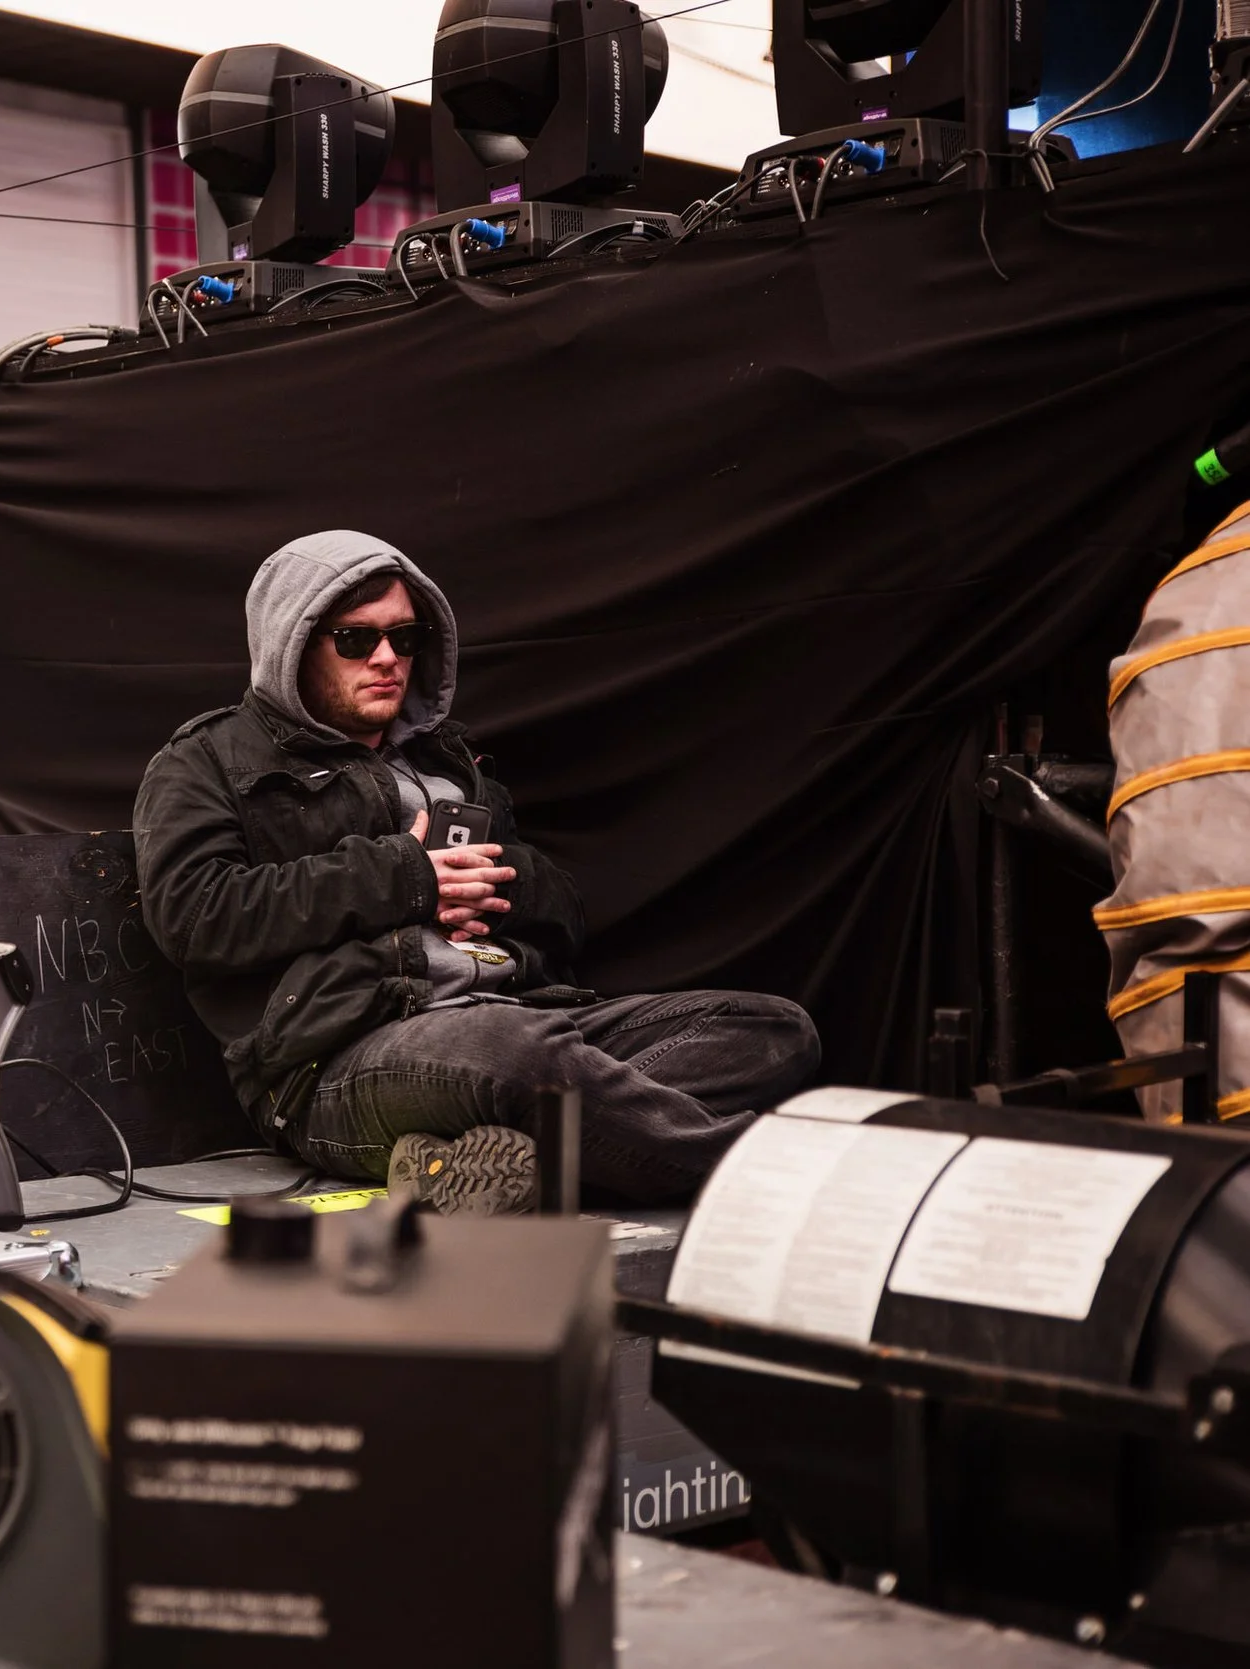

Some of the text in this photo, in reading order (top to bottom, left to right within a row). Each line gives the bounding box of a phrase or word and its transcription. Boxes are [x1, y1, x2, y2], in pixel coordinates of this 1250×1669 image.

[611, 40, 619, 59] 330
[320, 113, 328, 131] 330
[321, 132, 329, 159] WASH
[36, 914, 150, 994] NBC
[104, 1023, 191, 1083] EAST
